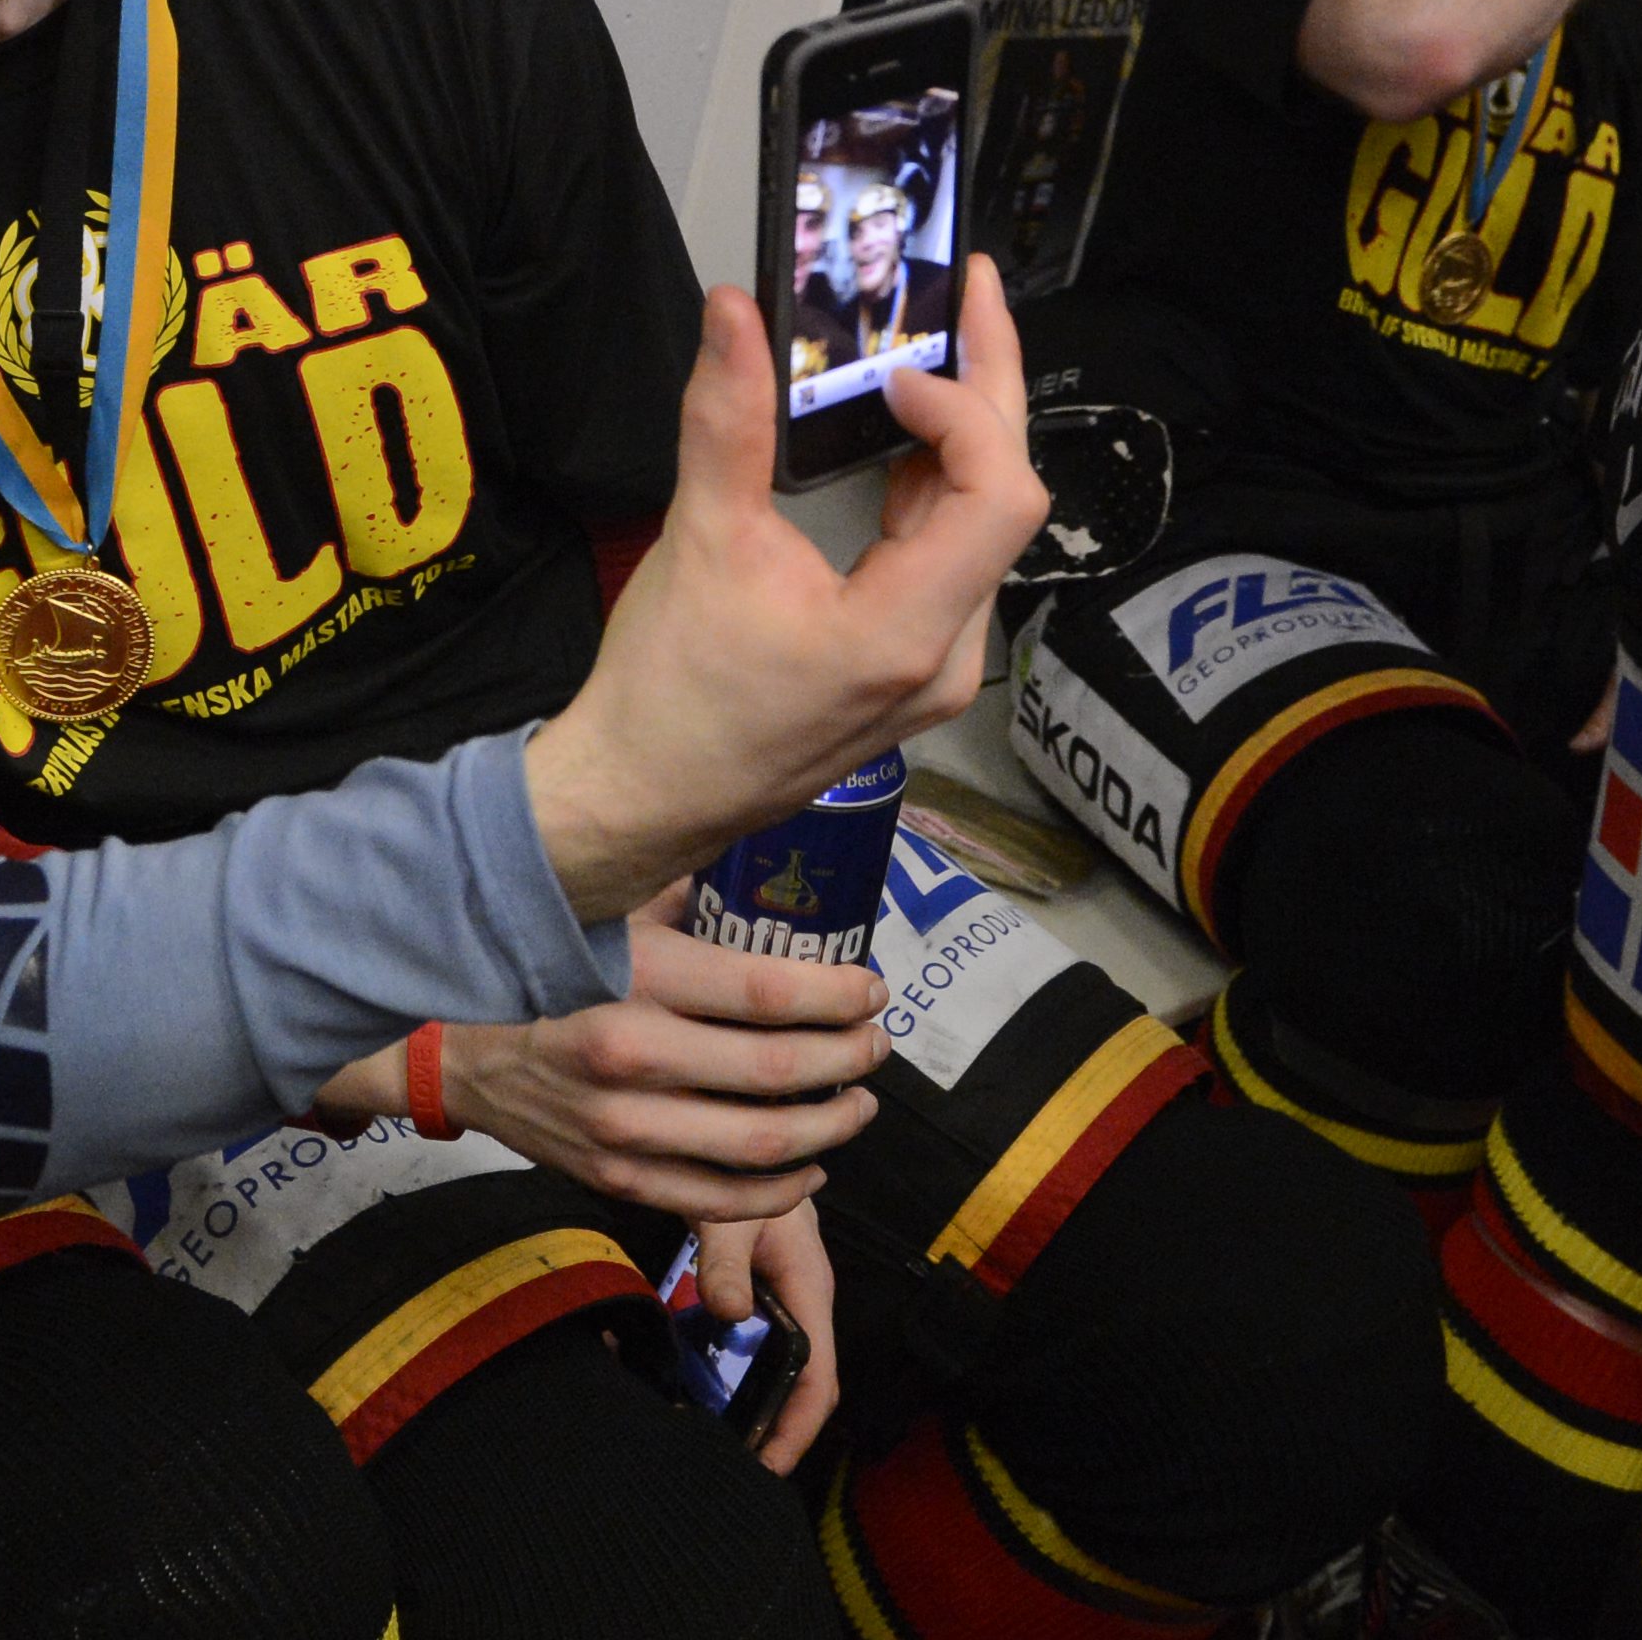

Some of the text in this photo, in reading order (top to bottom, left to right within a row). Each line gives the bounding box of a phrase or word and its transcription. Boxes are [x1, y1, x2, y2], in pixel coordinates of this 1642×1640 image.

[191, 234, 428, 368] ÄR
[160, 666, 273, 719] ENSKA
[411, 553, 476, 600] 2012
[846, 772, 878, 789] Beer
[1015, 675, 1168, 870] ŠKODA
[693, 882, 867, 966] Sofiero
